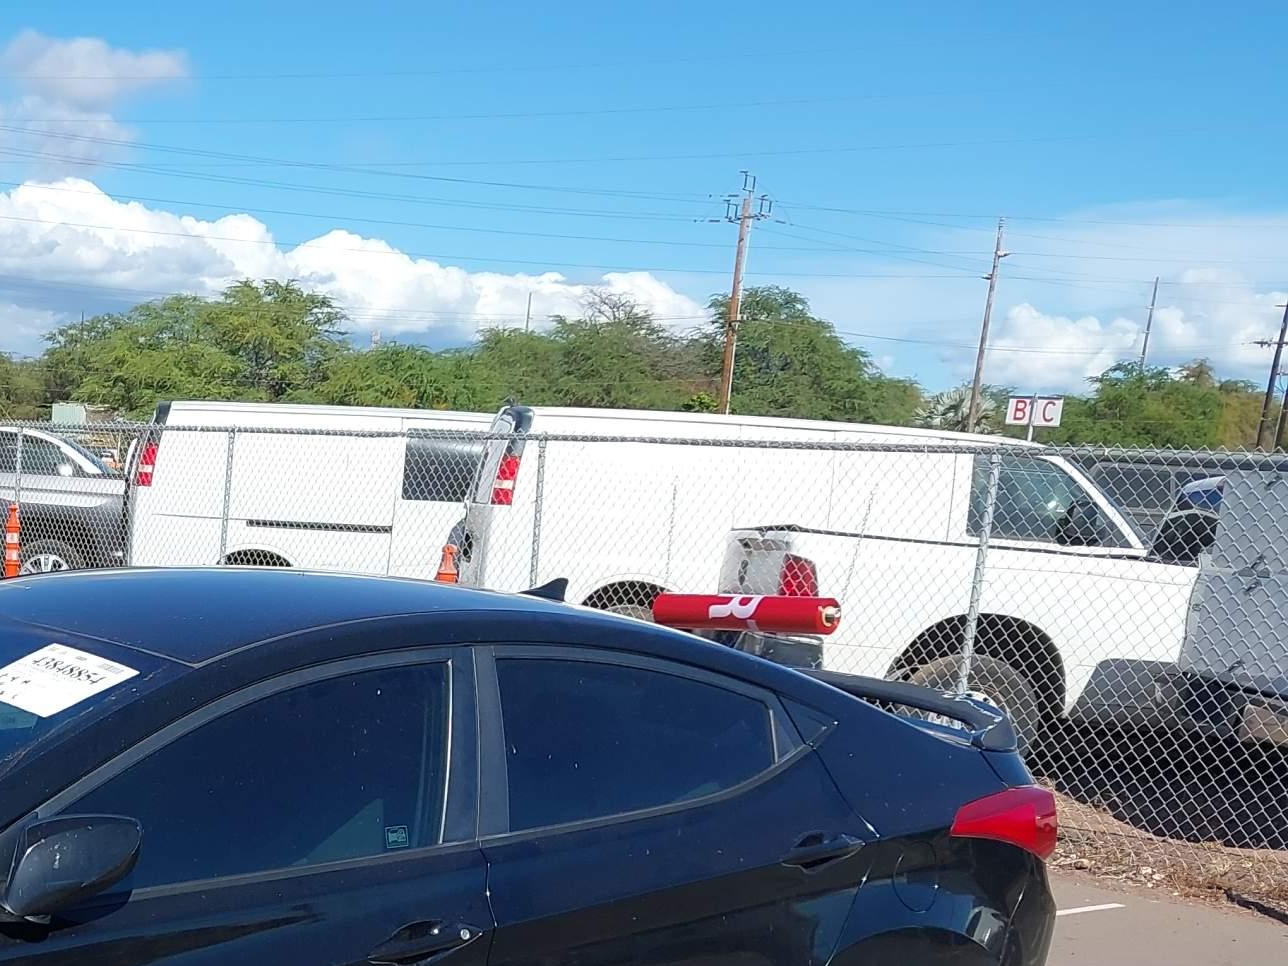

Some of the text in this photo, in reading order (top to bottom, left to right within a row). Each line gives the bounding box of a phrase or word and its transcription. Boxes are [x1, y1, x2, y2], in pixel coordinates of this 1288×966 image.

[1013, 399, 1028, 421] B
[1042, 400, 1057, 423] C
[31, 655, 108, 686] 43848854
